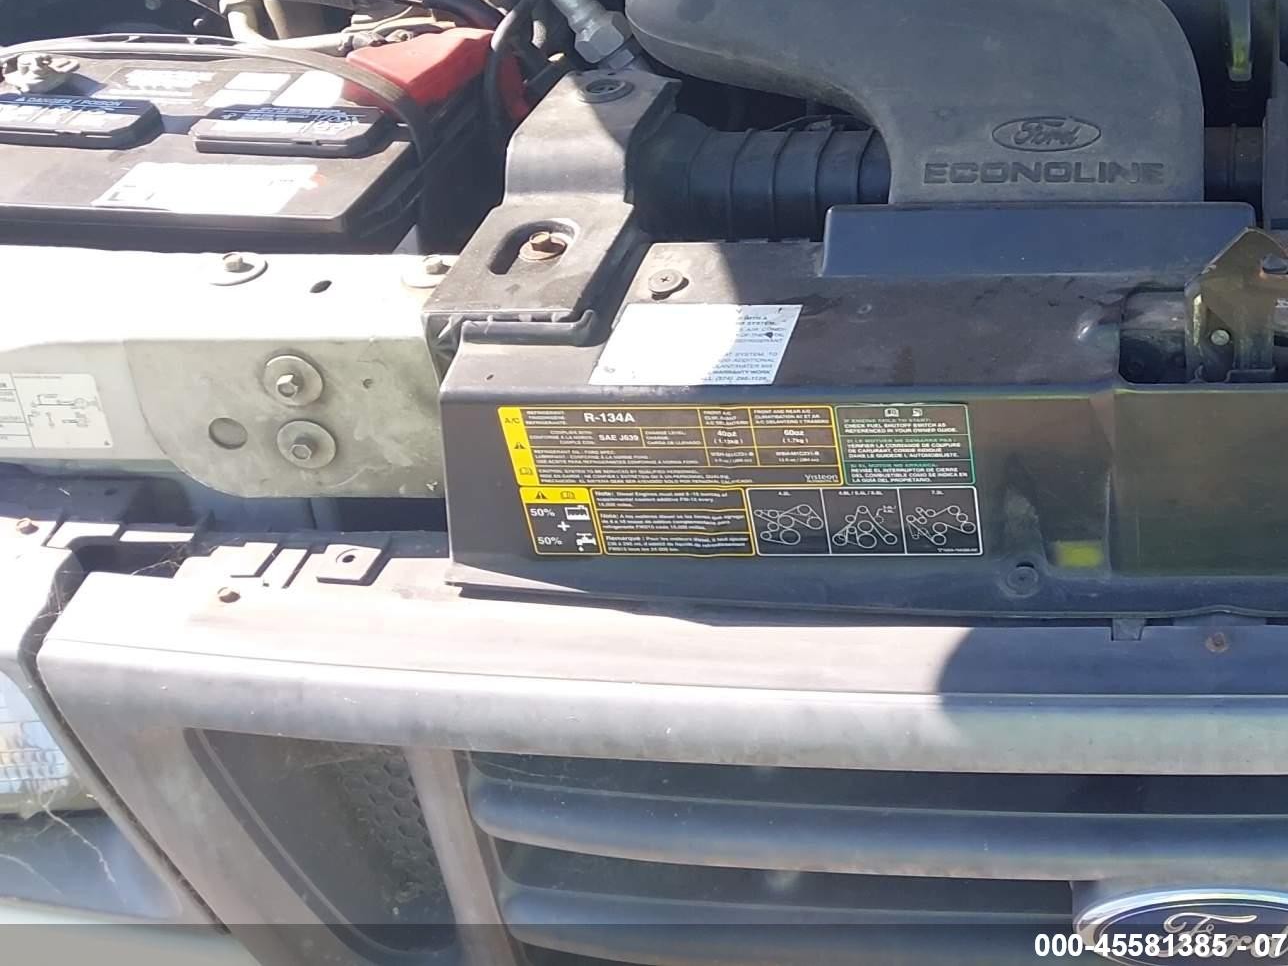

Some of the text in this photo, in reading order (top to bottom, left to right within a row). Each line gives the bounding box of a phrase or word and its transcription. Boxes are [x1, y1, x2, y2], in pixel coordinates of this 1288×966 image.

[1012, 120, 1081, 146] Ford
[923, 161, 1164, 184] ECONOLINE
[504, 417, 521, 425] A/C
[583, 412, 636, 423] R-134A
[716, 430, 737, 438] 40oz
[783, 429, 805, 437] 60oz
[598, 434, 616, 442] SAE
[618, 434, 639, 442] J639
[530, 508, 556, 517] 50%
[537, 536, 563, 545] 50%
